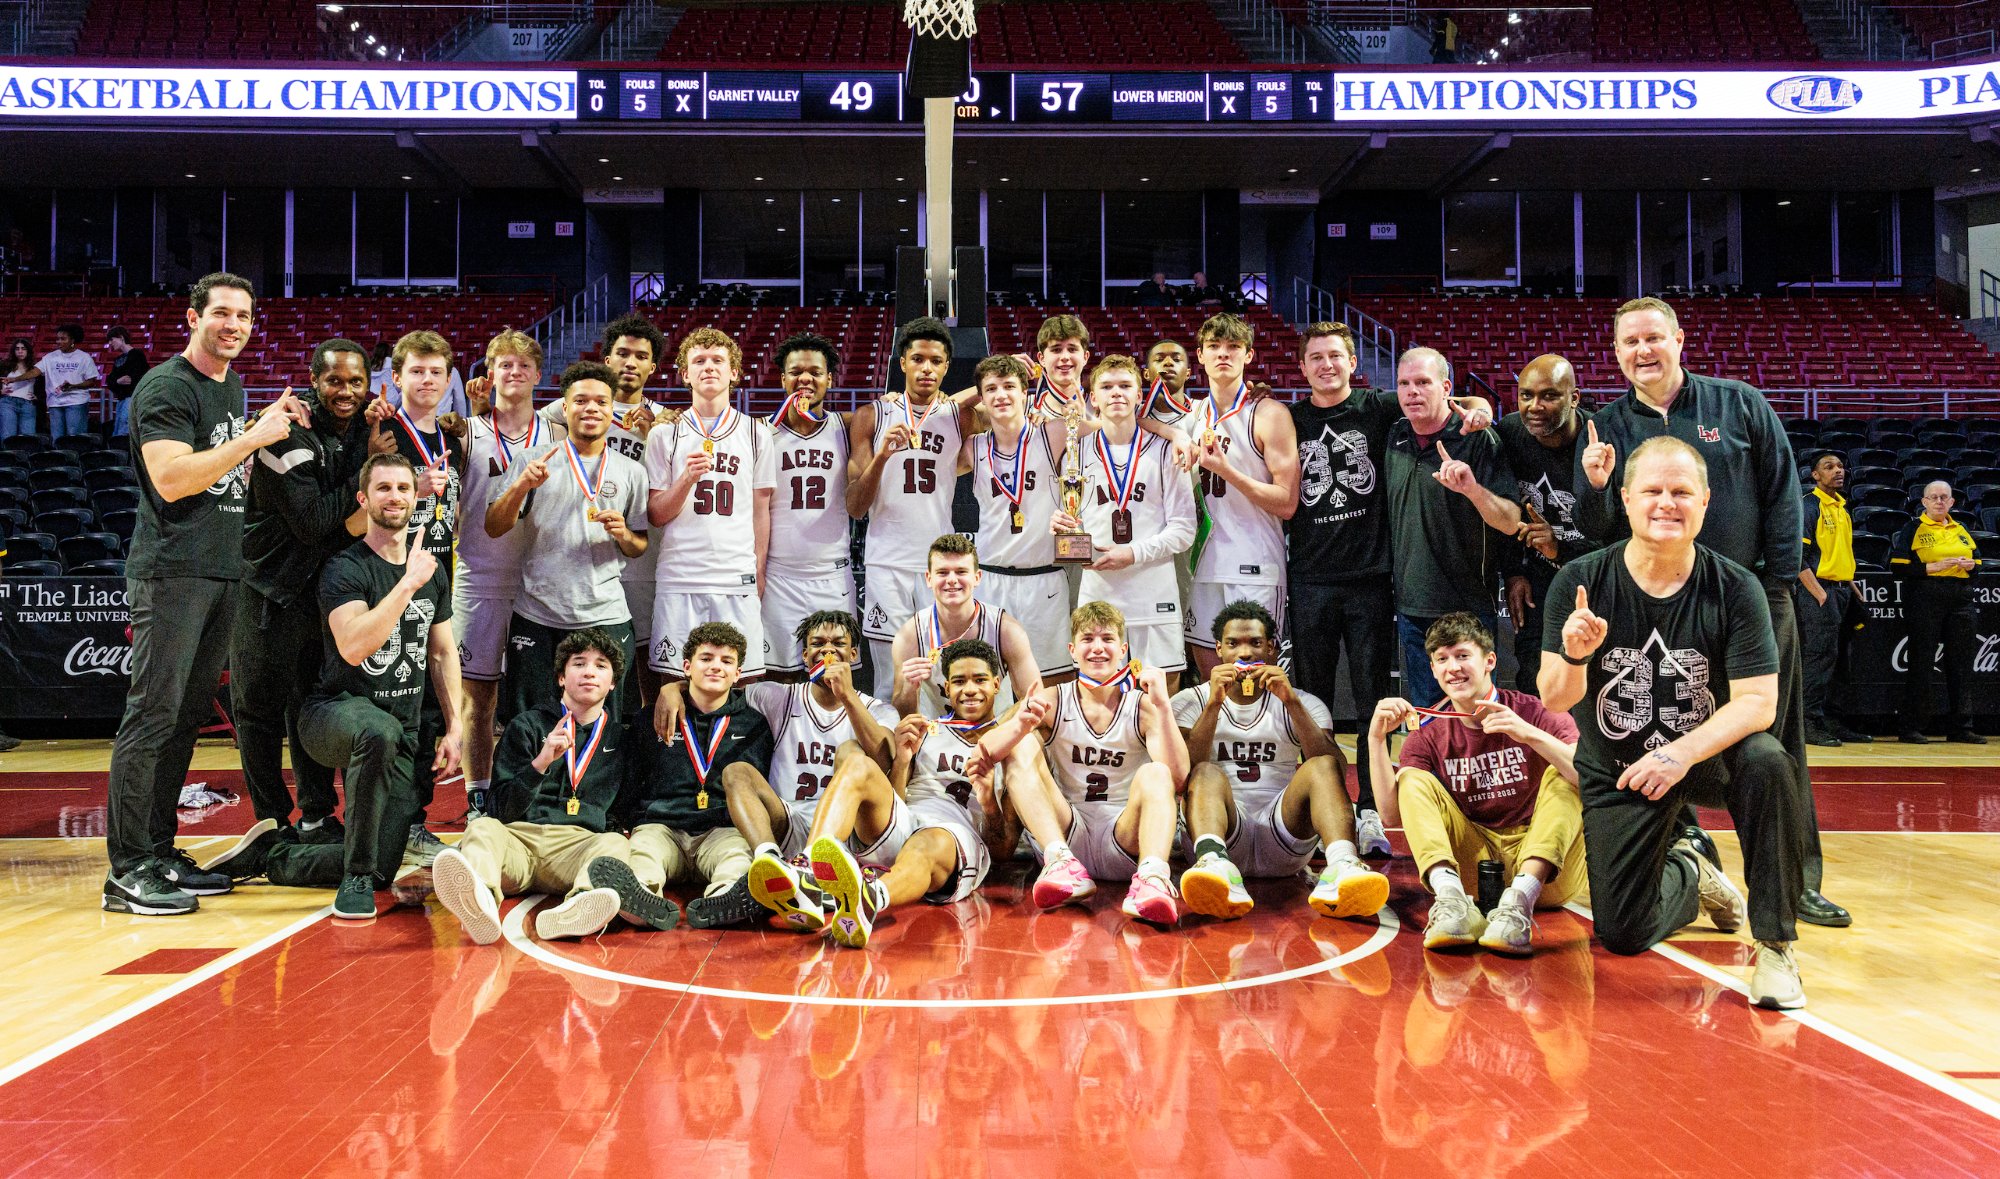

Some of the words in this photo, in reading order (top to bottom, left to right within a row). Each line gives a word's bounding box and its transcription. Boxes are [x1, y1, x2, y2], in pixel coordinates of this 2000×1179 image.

[512, 33, 532, 46] 207
[1366, 36, 1387, 48] 209
[588, 80, 606, 89] TOL
[625, 80, 655, 89] FOULS
[667, 80, 699, 89] BONUS
[1213, 82, 1244, 91] BONUS
[1257, 82, 1286, 91] FOULS
[1305, 82, 1323, 91] TOL
[0, 77, 272, 110] ASKETBALL
[708, 90, 754, 101] GARNET
[756, 90, 799, 102] VALLEY
[829, 81, 874, 111] 49
[1041, 82, 1084, 112] 57
[1113, 90, 1157, 102] LOWER
[1160, 90, 1204, 102] MERION
[1781, 80, 1857, 108] PIAA
[590, 95, 603, 112] 0
[634, 95, 646, 112] 5
[676, 95, 690, 112] X
[957, 106, 979, 117] QTR
[1222, 97, 1236, 113] X
[1265, 97, 1277, 113] 5
[1309, 98, 1318, 113] 1
[515, 225, 529, 233] 107
[558, 224, 571, 234] EXIT
[1376, 226, 1391, 234] 109
[1697, 425, 1721, 442] LM
[781, 449, 834, 471] ACES
[903, 458, 937, 494] 15
[693, 479, 735, 516] 50
[790, 475, 826, 510] 12
[1314, 516, 1328, 524] THE
[1329, 509, 1367, 522] GREATEST
[18, 583, 66, 607] The
[17, 611, 72, 623] TEMPLE
[76, 611, 131, 622] UNIVER
[374, 690, 389, 698] THE
[1601, 646, 1709, 733] 33
[1609, 713, 1645, 731] MAMBA
[1071, 744, 1127, 768] ACES
[1217, 741, 1277, 762] ACES
[1444, 746, 1527, 775] WHATEVER
[1084, 772, 1109, 802] 2
[1450, 775, 1468, 792] IT
[1467, 791, 1496, 803] STATES
[1497, 788, 1517, 798] 2022
